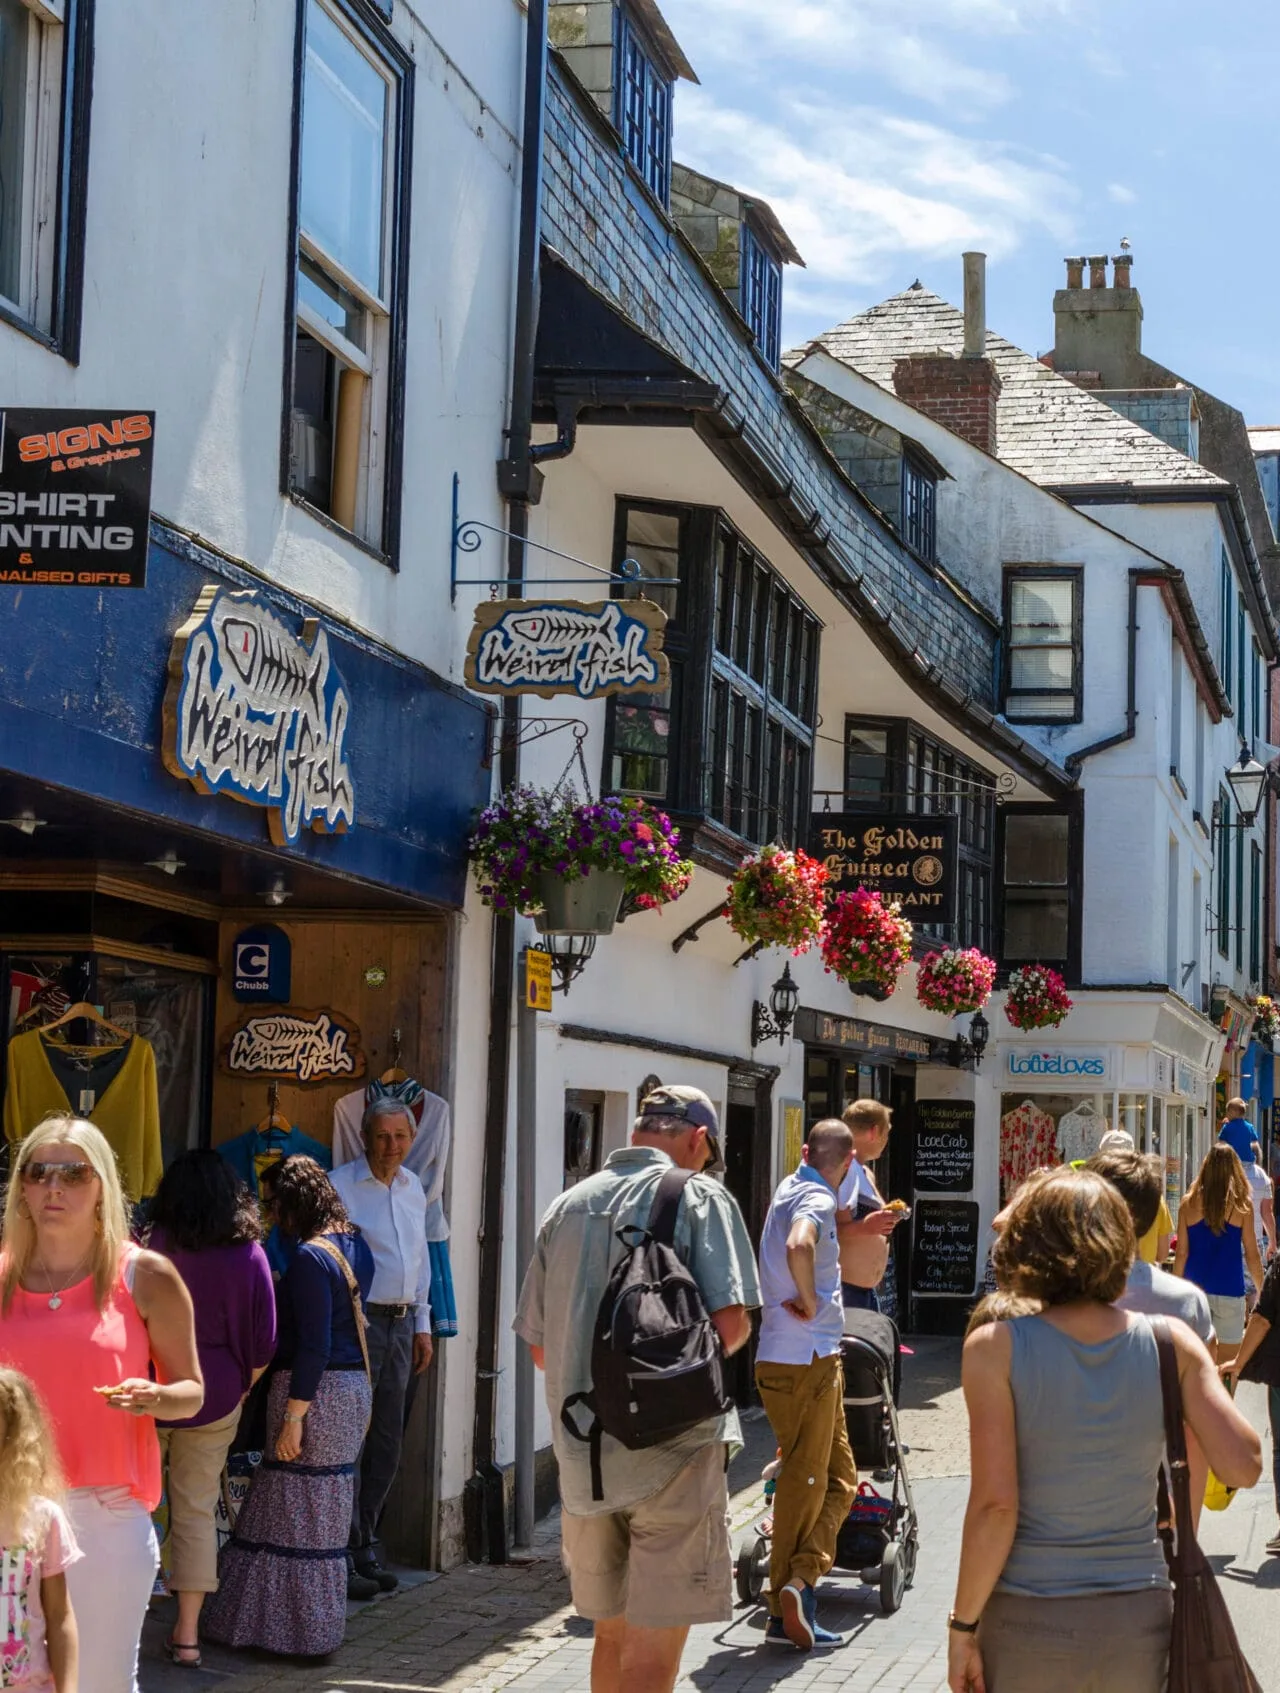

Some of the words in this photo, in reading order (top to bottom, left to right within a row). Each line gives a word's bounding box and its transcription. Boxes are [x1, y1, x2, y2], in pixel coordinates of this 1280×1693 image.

[18, 414, 152, 462] SIGNS
[51, 459, 66, 472] &
[67, 447, 141, 471] Graphics
[0, 492, 115, 518] SHIRT
[18, 553, 34, 565] &
[77, 571, 132, 585] GIFTS
[484, 635, 576, 678] Weird
[821, 828, 856, 850] The
[863, 825, 944, 857] Golden
[825, 853, 910, 883] Guinea
[235, 980, 269, 990] Chubb
